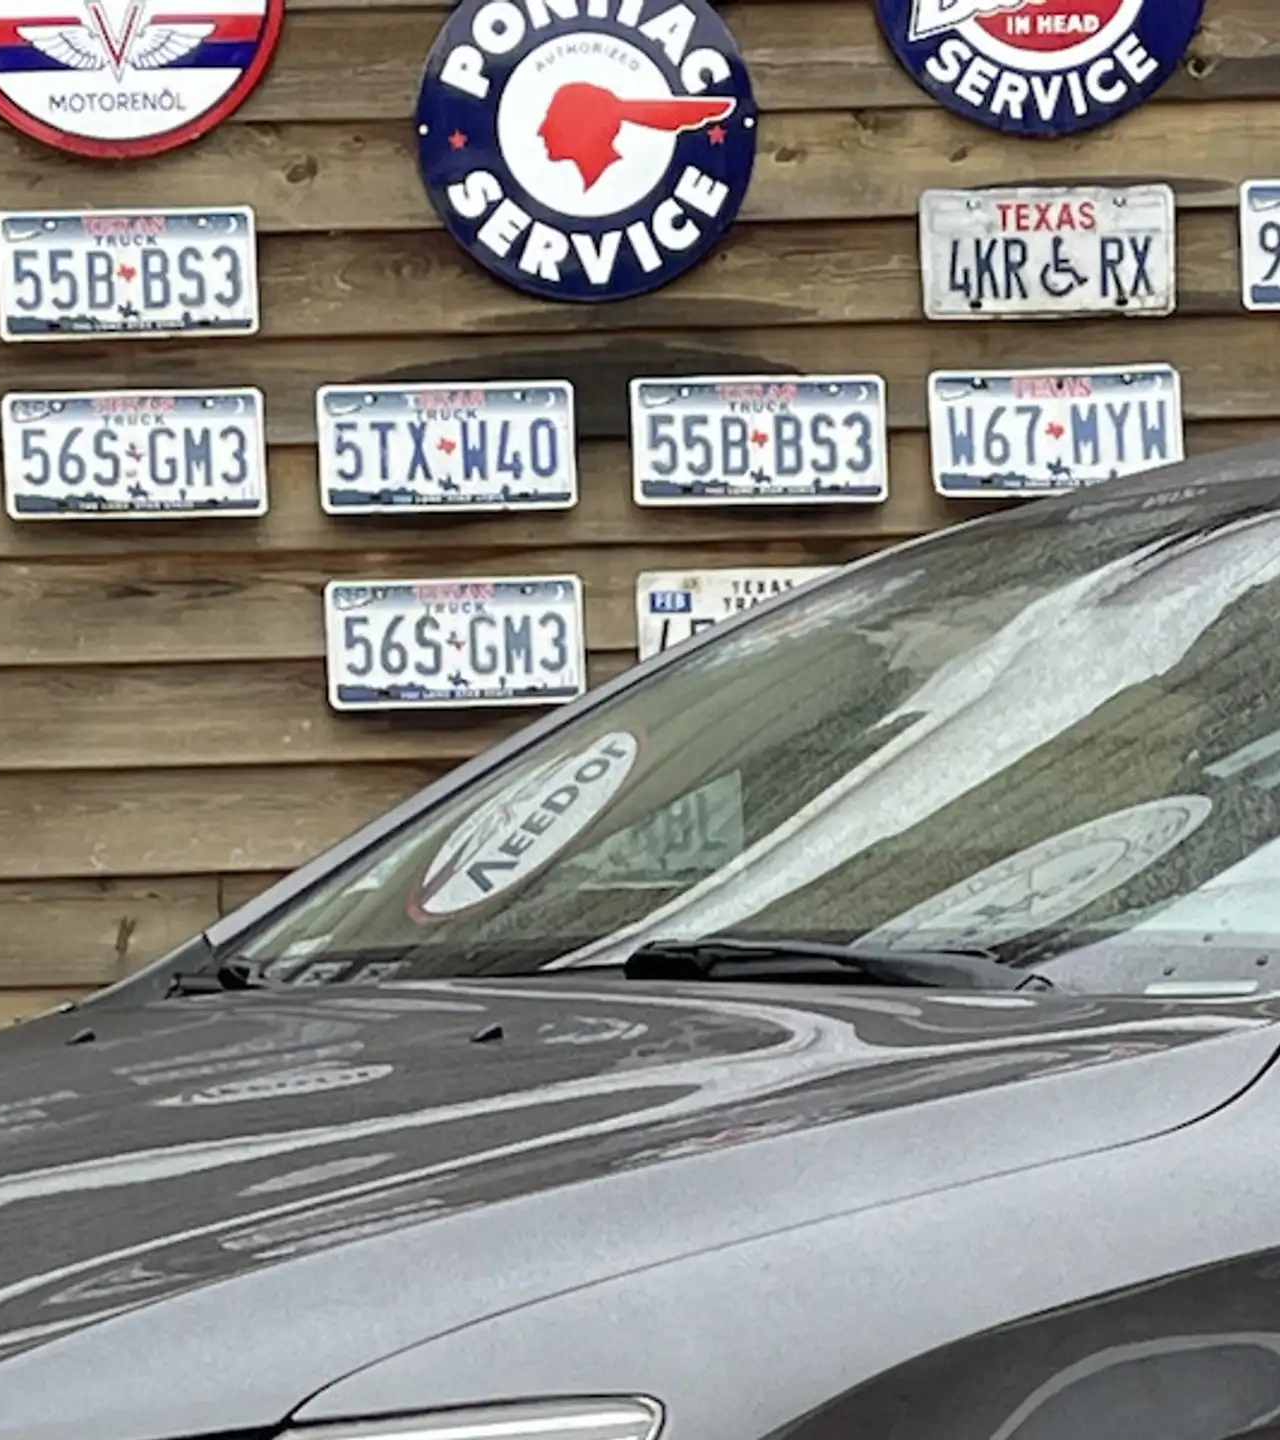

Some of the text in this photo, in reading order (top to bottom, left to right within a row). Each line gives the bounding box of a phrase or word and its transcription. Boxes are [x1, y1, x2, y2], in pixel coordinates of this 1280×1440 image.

[1006, 14, 1100, 35] IN HEAD
[535, 42, 640, 72] AUTHORIZED
[925, 35, 1159, 120] SERVICE
[48, 90, 186, 112] MOTORENÖL
[447, 166, 730, 284] SERVICE
[997, 202, 1096, 231] TEXAS
[13, 246, 242, 310] 55B BS3
[949, 236, 1156, 299] 4KR RX
[22, 426, 247, 487] 56S GM3
[334, 420, 432, 482] 5TX
[648, 412, 872, 476] 55B BS3
[948, 401, 1166, 466] W67 MYW
[344, 612, 566, 676] 56S GM3
